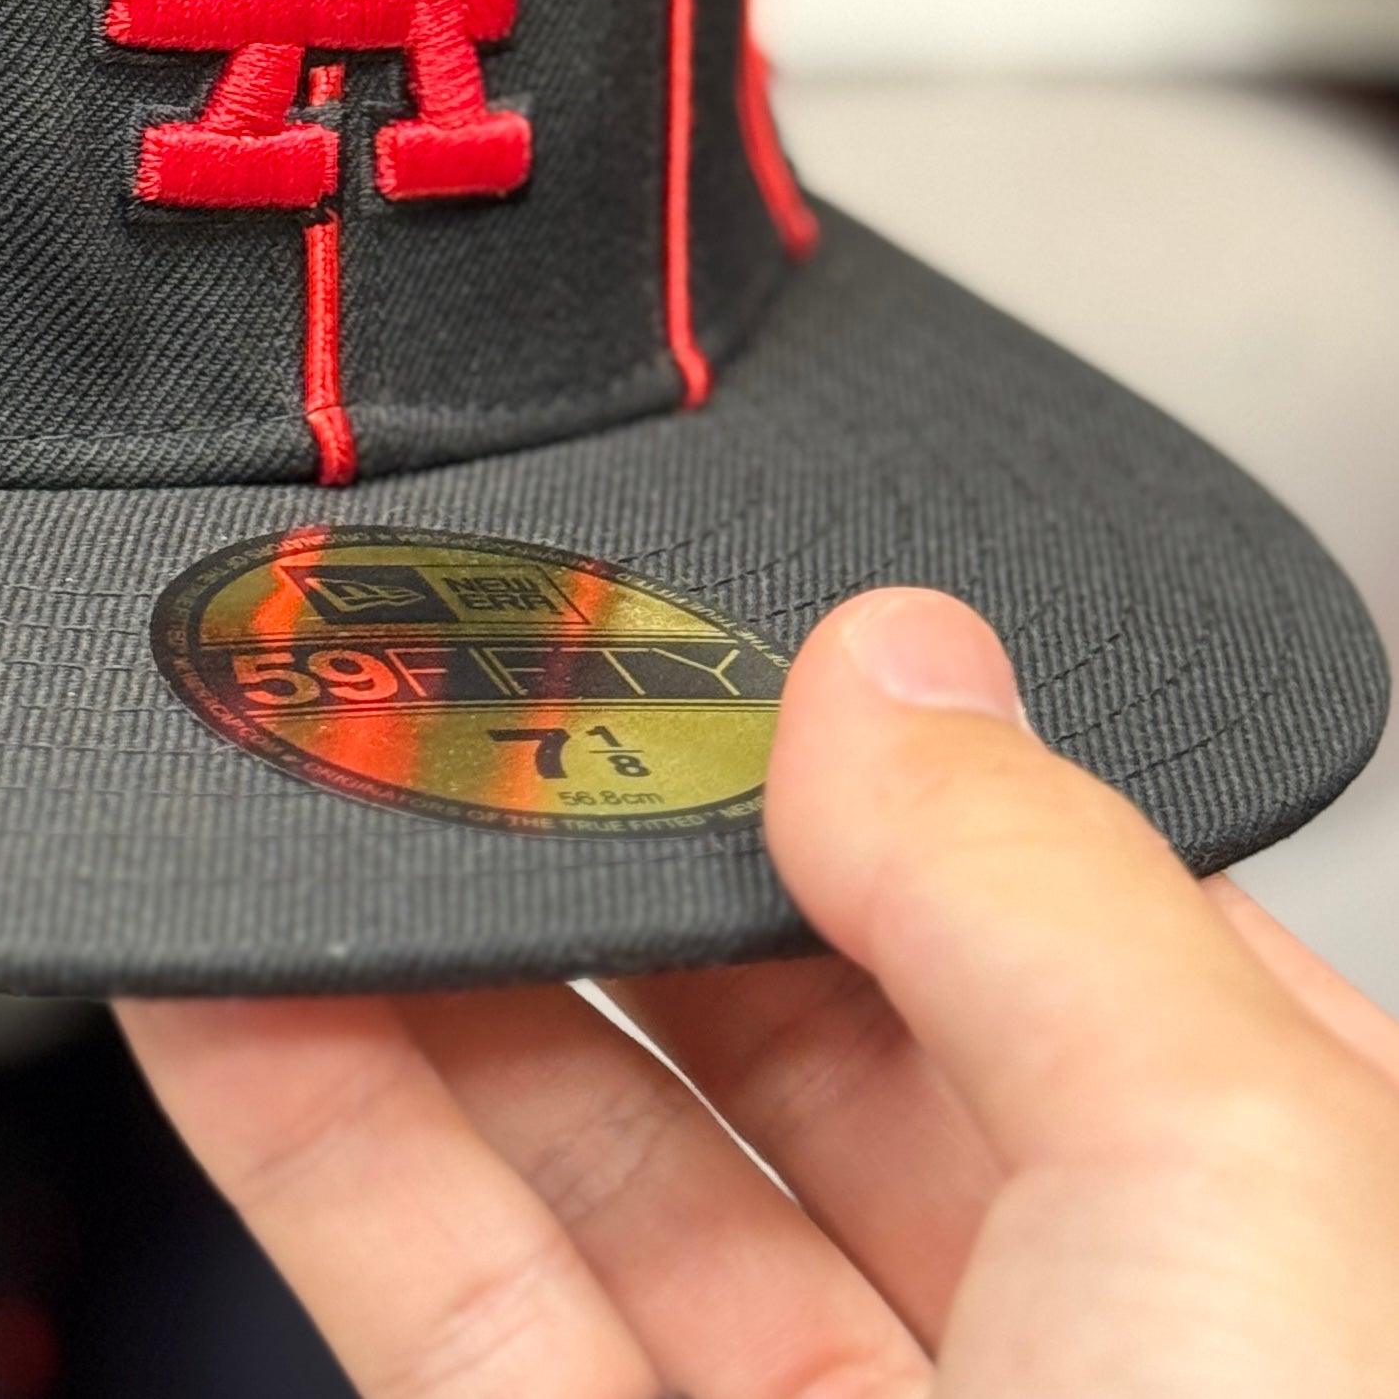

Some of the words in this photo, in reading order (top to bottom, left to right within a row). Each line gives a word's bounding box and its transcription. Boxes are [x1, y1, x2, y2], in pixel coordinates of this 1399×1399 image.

[443, 577, 541, 593] NEW
[229, 647, 741, 706] 59FIFTY
[487, 727, 567, 781] 7
[557, 788, 664, 807] 56.8cm
[507, 813, 556, 830] THE
[565, 817, 626, 833] TRUE
[627, 813, 706, 833] FITTED
